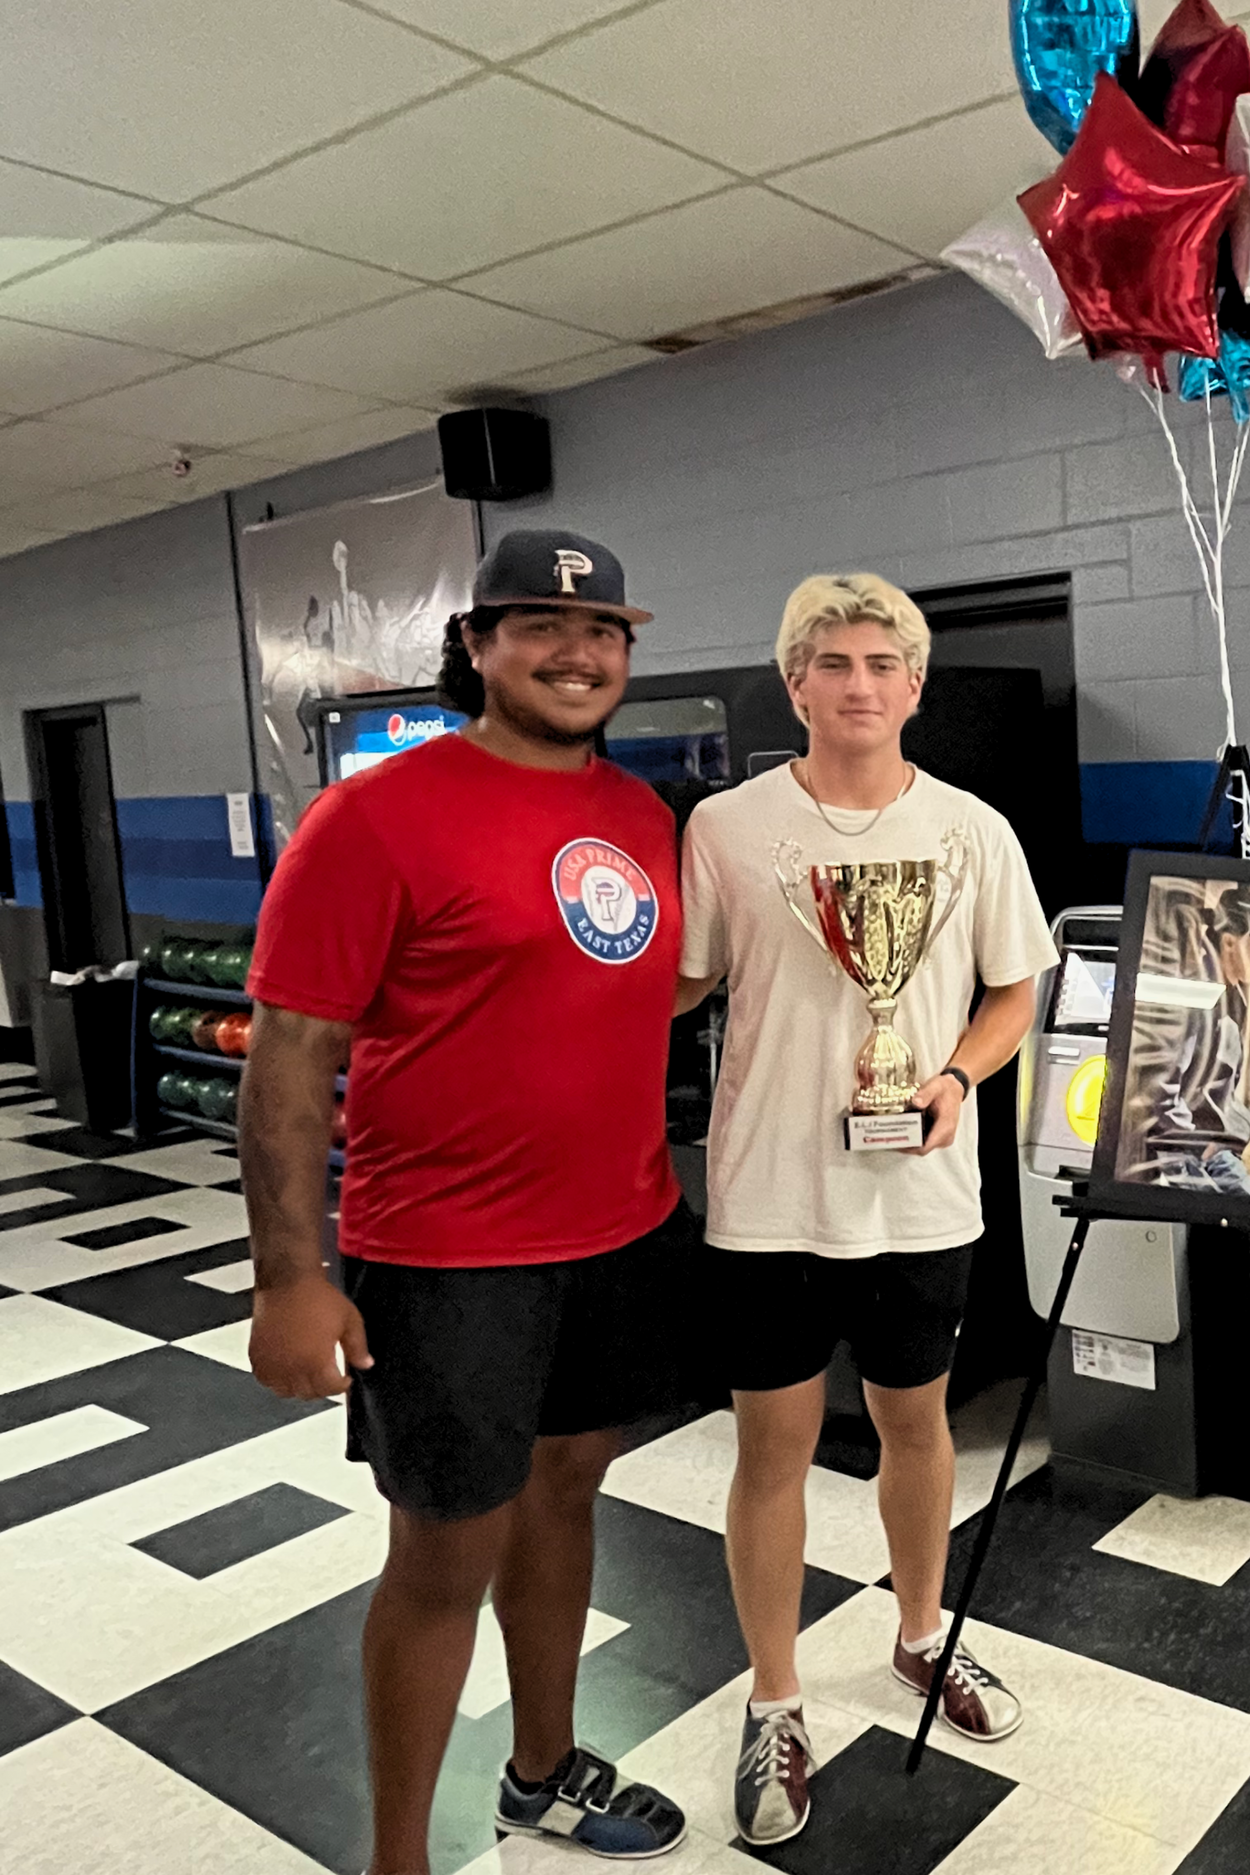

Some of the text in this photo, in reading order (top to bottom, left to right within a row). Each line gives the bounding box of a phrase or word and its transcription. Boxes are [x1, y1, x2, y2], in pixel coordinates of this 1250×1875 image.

[408, 714, 446, 741] pepsi
[563, 848, 637, 881] USA PRIME
[577, 914, 650, 955] EAST TEXAS
